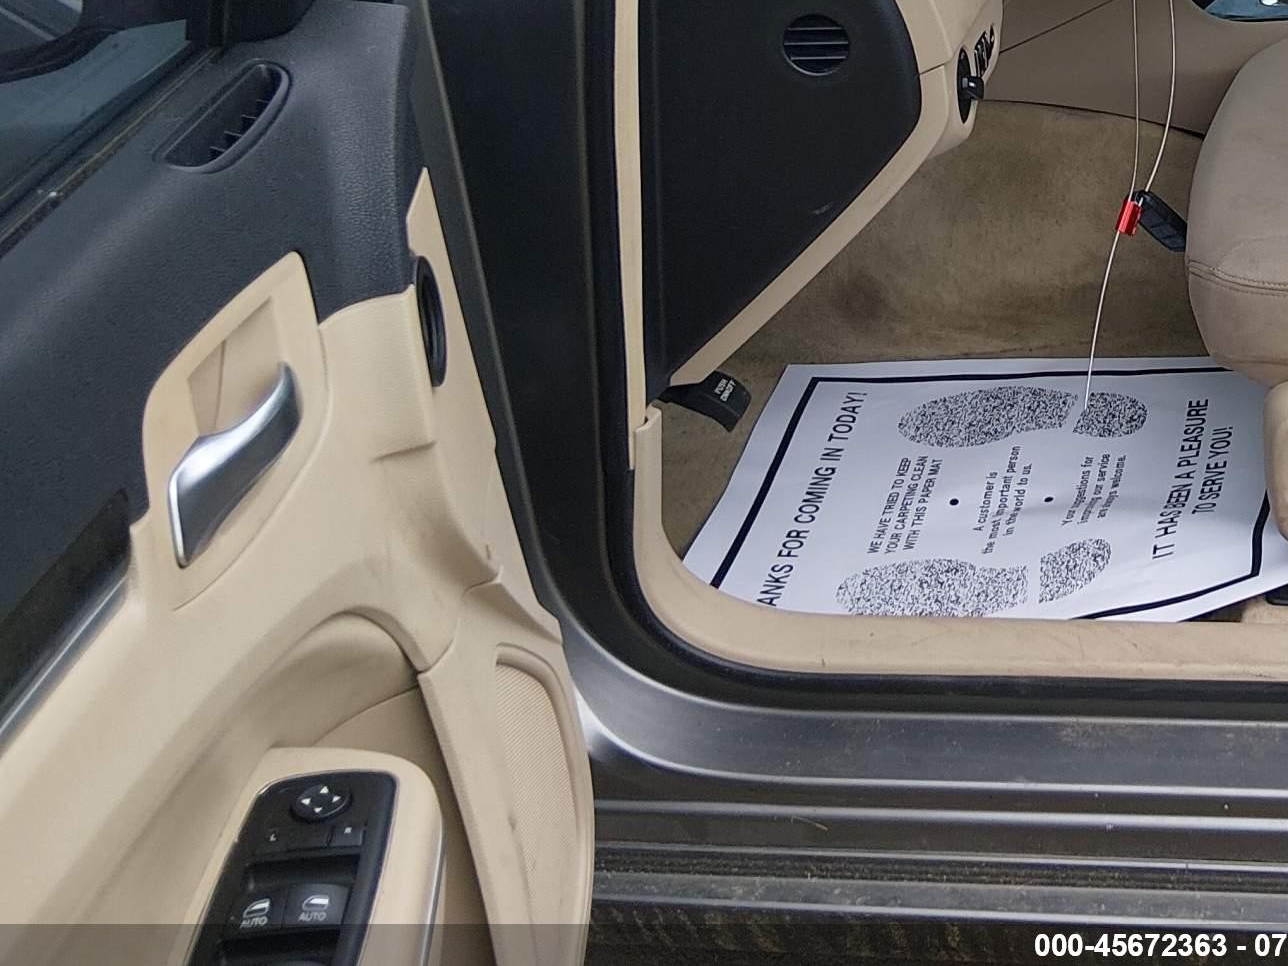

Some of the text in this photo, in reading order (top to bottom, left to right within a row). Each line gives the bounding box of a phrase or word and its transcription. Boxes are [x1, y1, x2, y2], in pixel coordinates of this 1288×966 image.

[757, 392, 868, 607] ANKS FOR COMING IN TODAY!
[867, 458, 911, 553] WE HAVE TRIED TO KEEP
[884, 456, 928, 554] YOUR CARPETING CLEAN
[903, 459, 942, 550] WITH THIS PAPER MAT
[978, 481, 995, 523] customer
[982, 541, 995, 554] the
[989, 518, 1001, 539] most
[1007, 446, 1020, 473] person
[1003, 527, 1014, 536] in
[1017, 477, 1028, 485] to
[1061, 457, 1093, 526] You ggestions for
[1097, 454, 1110, 481] service
[1153, 399, 1208, 559] IT HAS BEEN A PLEASURE
[1192, 427, 1233, 514] TO SERVE YOU!
[1097, 509, 1108, 518] ar
[240, 912, 327, 928] AUTO AUTO
